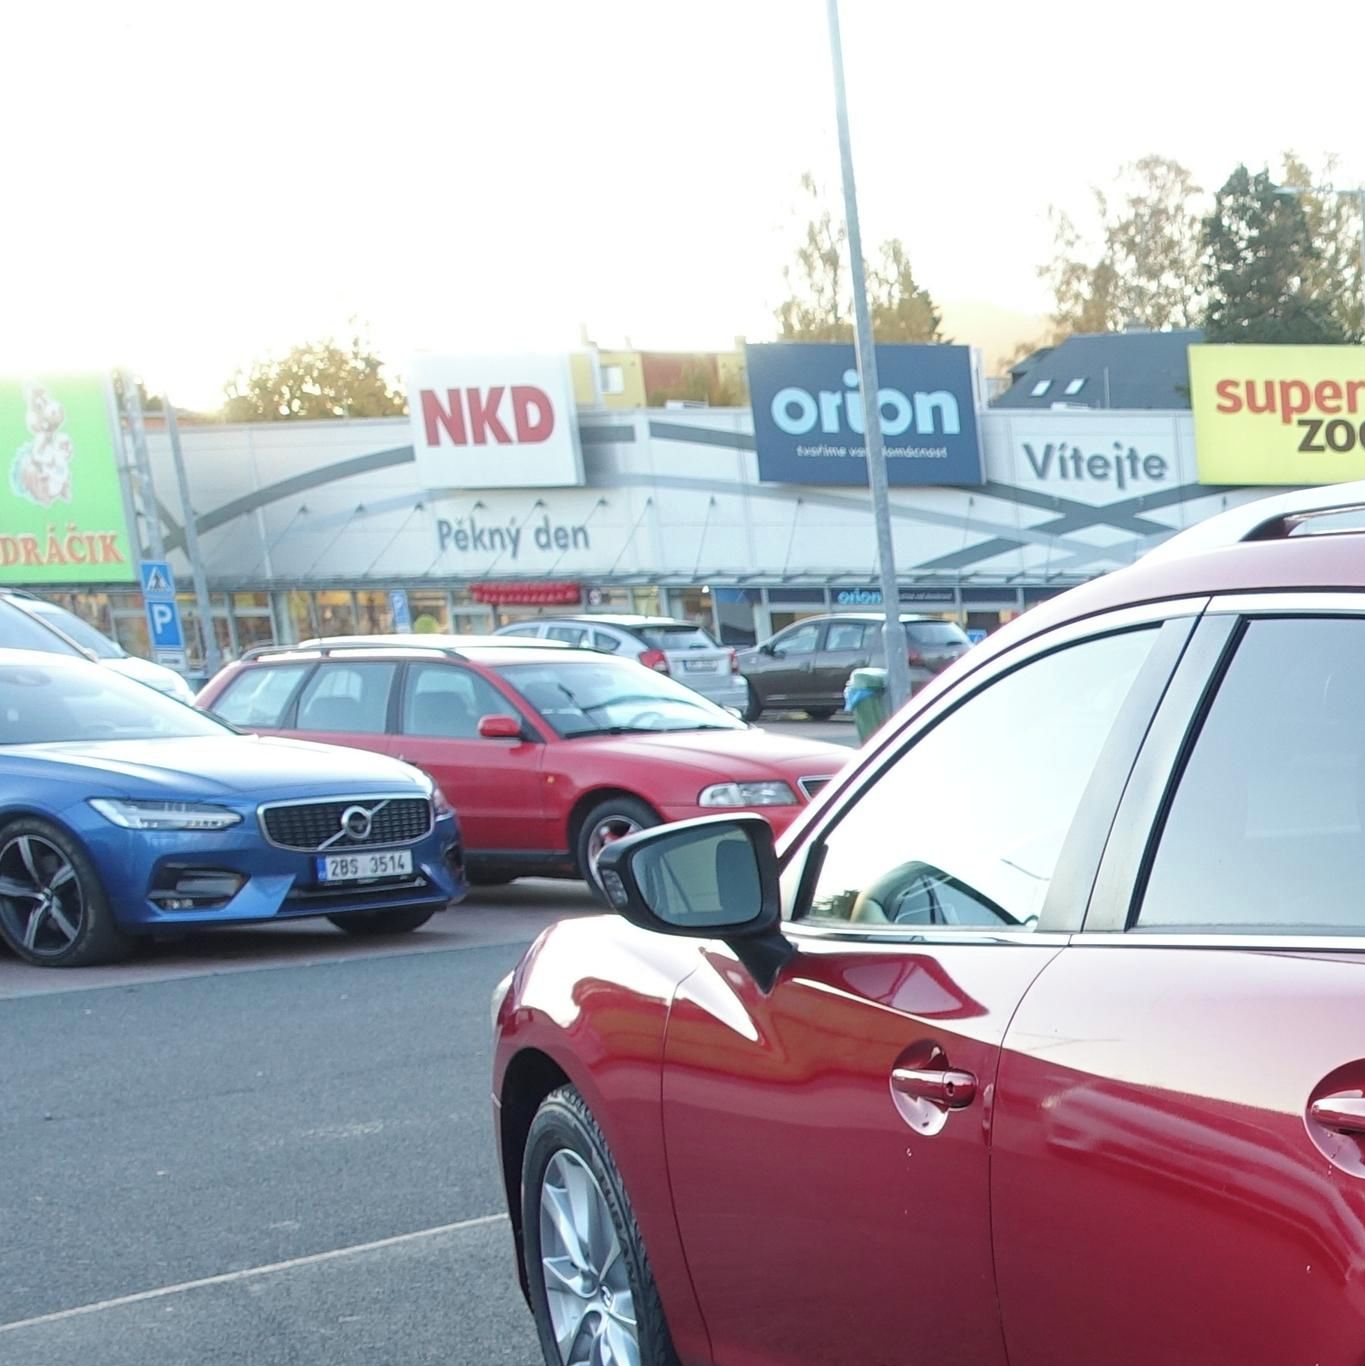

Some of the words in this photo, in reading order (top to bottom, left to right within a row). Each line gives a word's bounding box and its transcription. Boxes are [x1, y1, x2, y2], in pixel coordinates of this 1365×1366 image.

[420, 385, 555, 446] NKD
[771, 368, 960, 436] orion
[1022, 440, 1168, 490] Vítejte
[0, 522, 125, 566] DRÁČIK
[437, 516, 520, 559] Pěkný
[535, 515, 590, 550] den
[153, 603, 173, 635] P
[330, 858, 358, 877] 2BS
[369, 855, 405, 874] 3514
